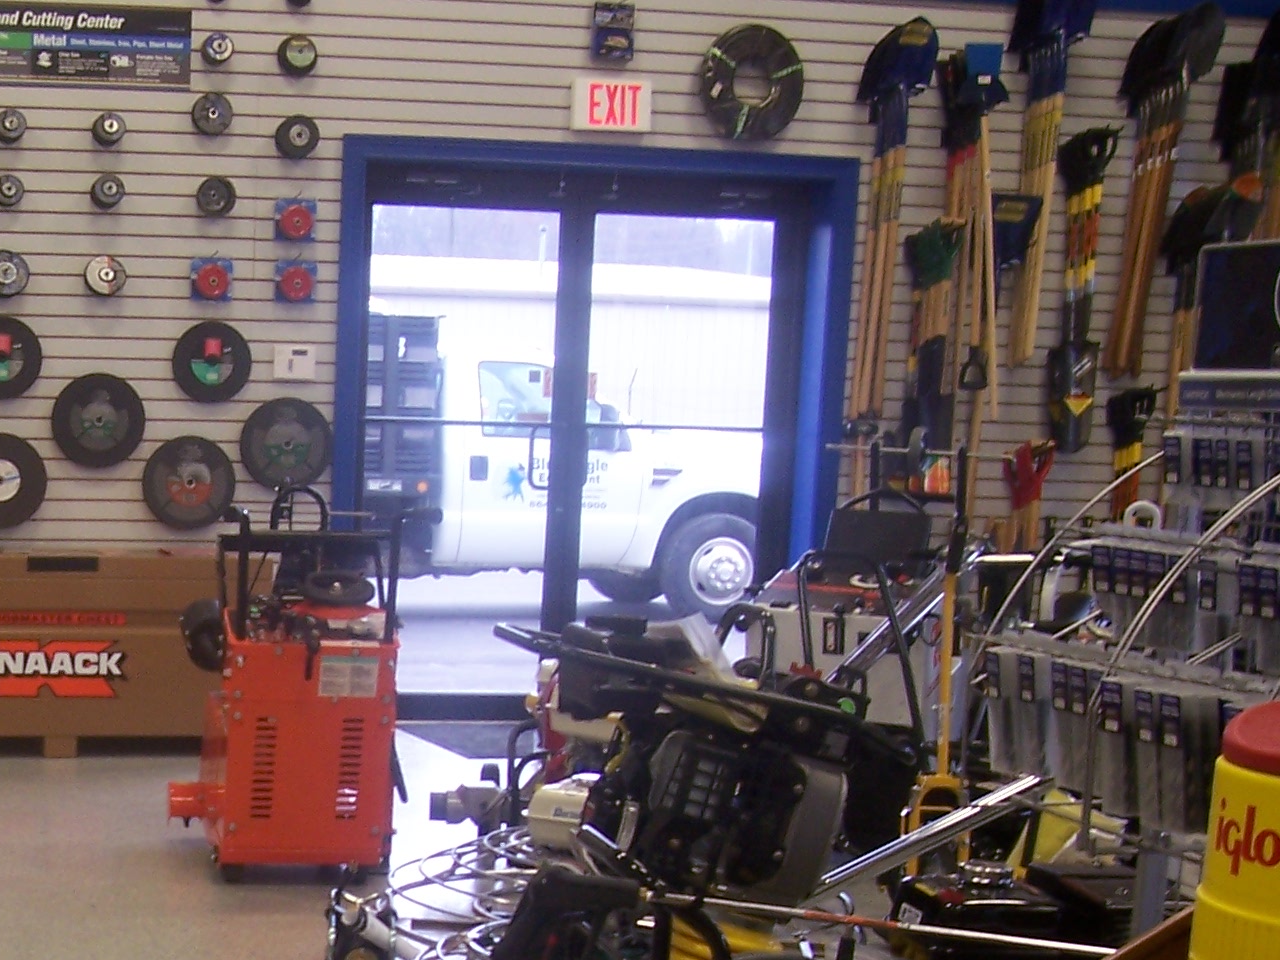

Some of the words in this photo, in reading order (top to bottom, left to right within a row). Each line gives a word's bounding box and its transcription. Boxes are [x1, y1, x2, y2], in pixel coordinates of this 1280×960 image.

[22, 10, 74, 30] Cutting
[77, 12, 125, 29] Center
[33, 33, 67, 47] Metal
[589, 83, 642, 127] EXIT
[1215, 797, 1280, 877] iglo
